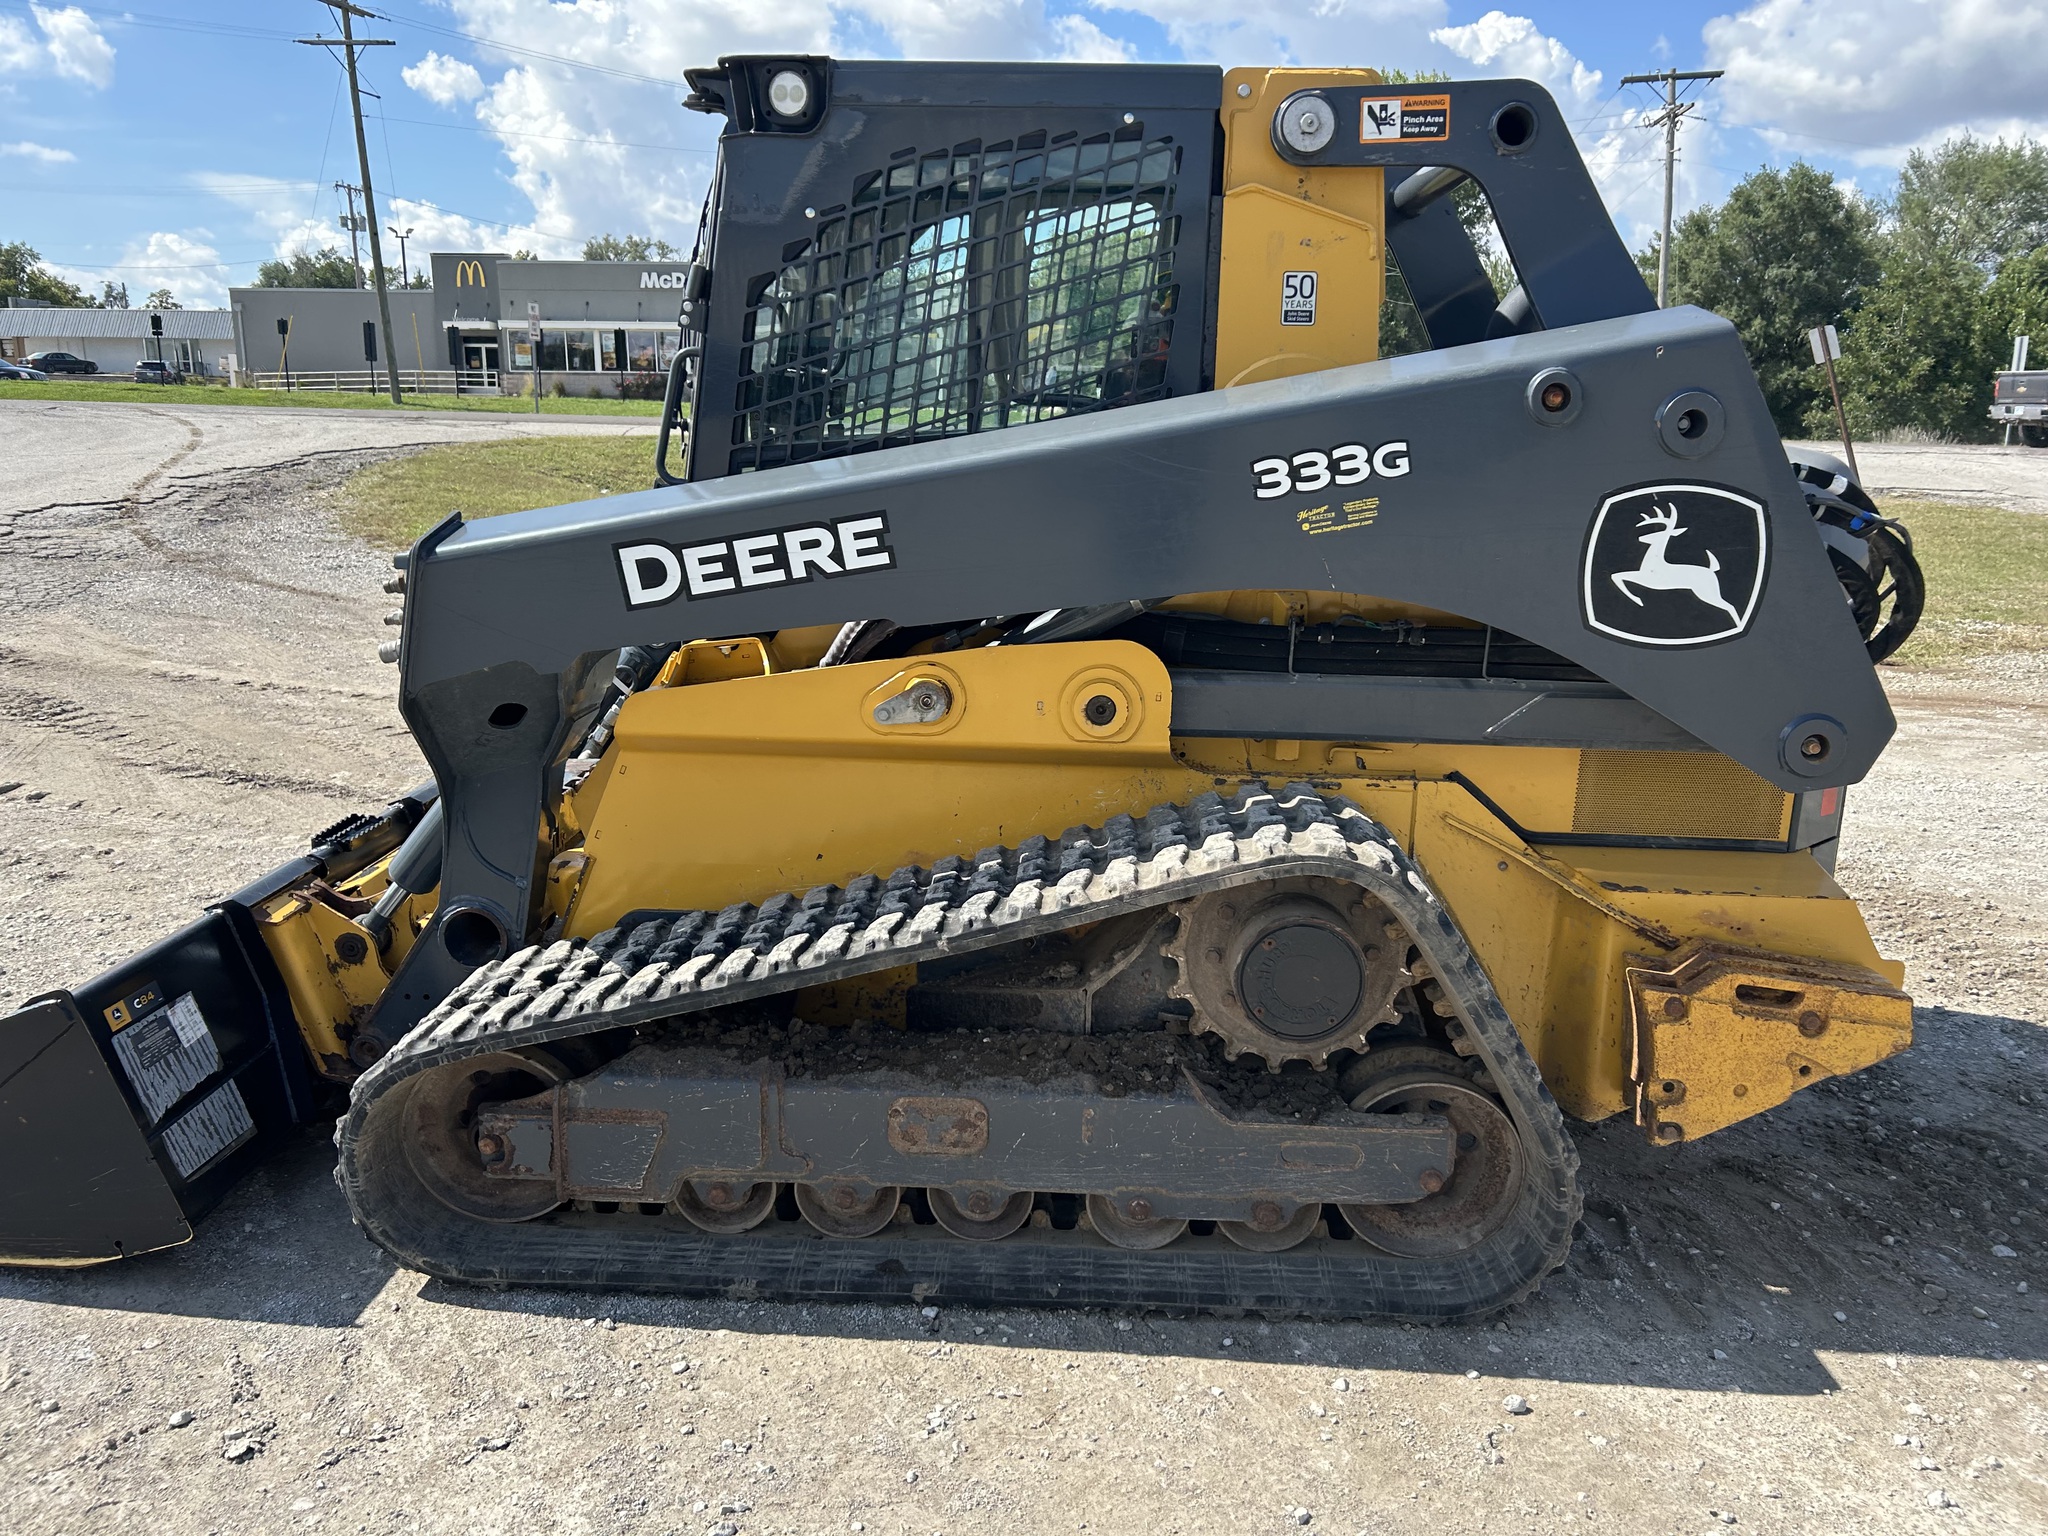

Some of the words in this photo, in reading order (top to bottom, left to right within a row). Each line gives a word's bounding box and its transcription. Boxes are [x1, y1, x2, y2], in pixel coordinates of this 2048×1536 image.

[1411, 99, 1446, 107] WARNING
[1284, 274, 1315, 299] 50
[1284, 300, 1314, 309] YEARS
[1253, 442, 1410, 498] 333G
[618, 516, 891, 606] DEERE
[133, 991, 155, 1009] C84
